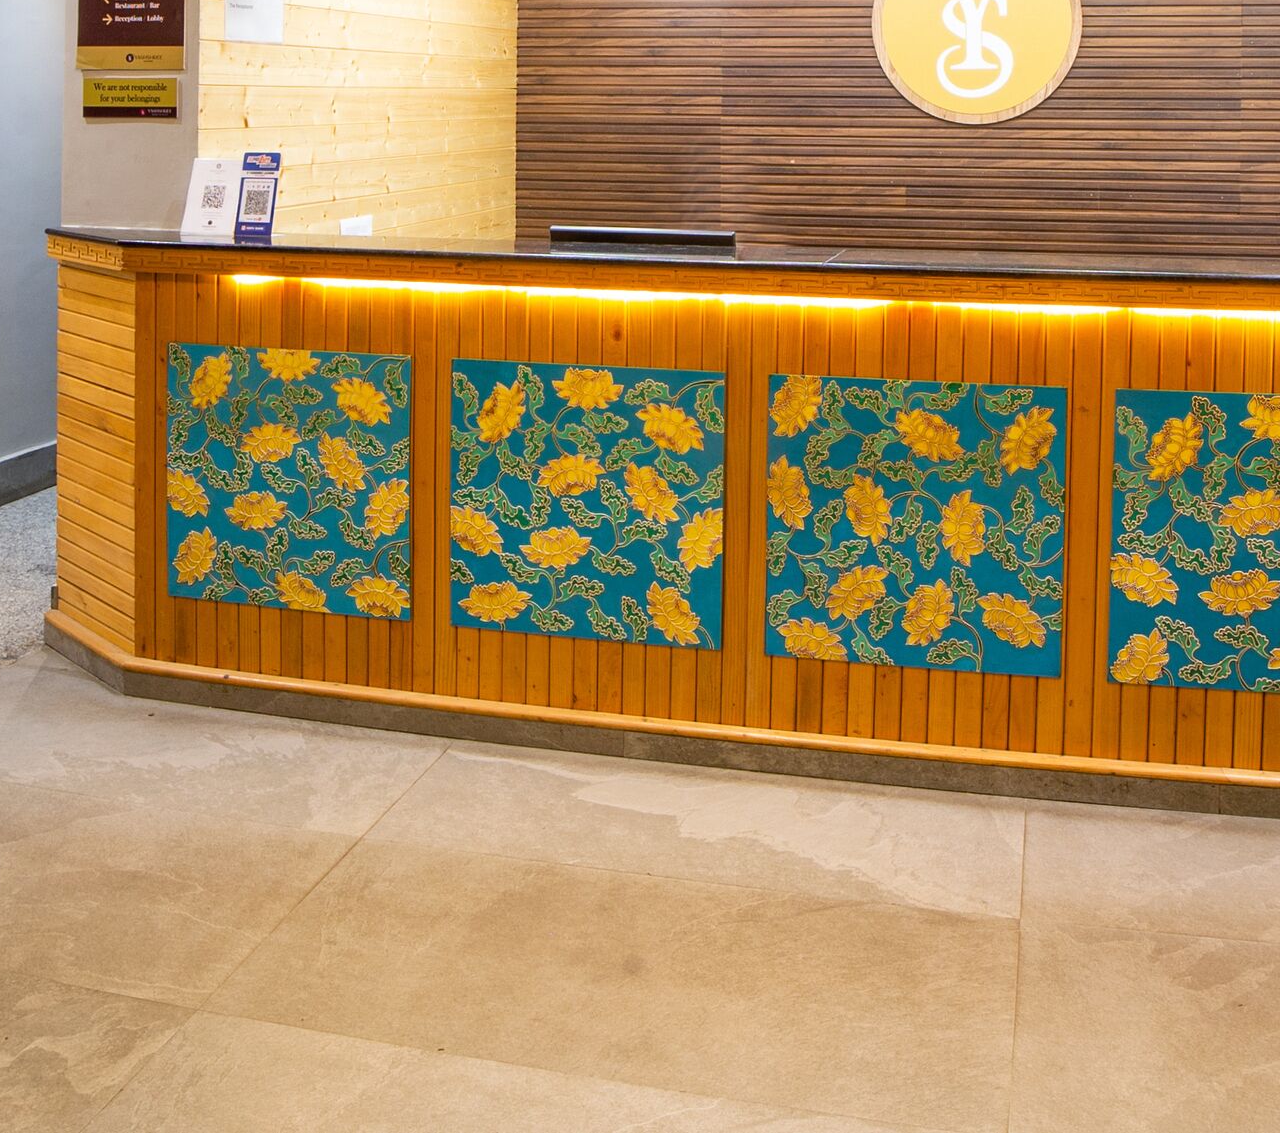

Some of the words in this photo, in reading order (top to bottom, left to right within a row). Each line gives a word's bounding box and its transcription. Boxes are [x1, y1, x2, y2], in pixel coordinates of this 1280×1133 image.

[114, 15, 143, 23] Reception
[147, 14, 164, 23] Lobby
[93, 82, 107, 92] We
[107, 84, 118, 92] are
[118, 83, 130, 92] not
[131, 82, 168, 93] responsible
[99, 93, 110, 103] for
[111, 95, 126, 105] your
[127, 94, 161, 105] belongings
